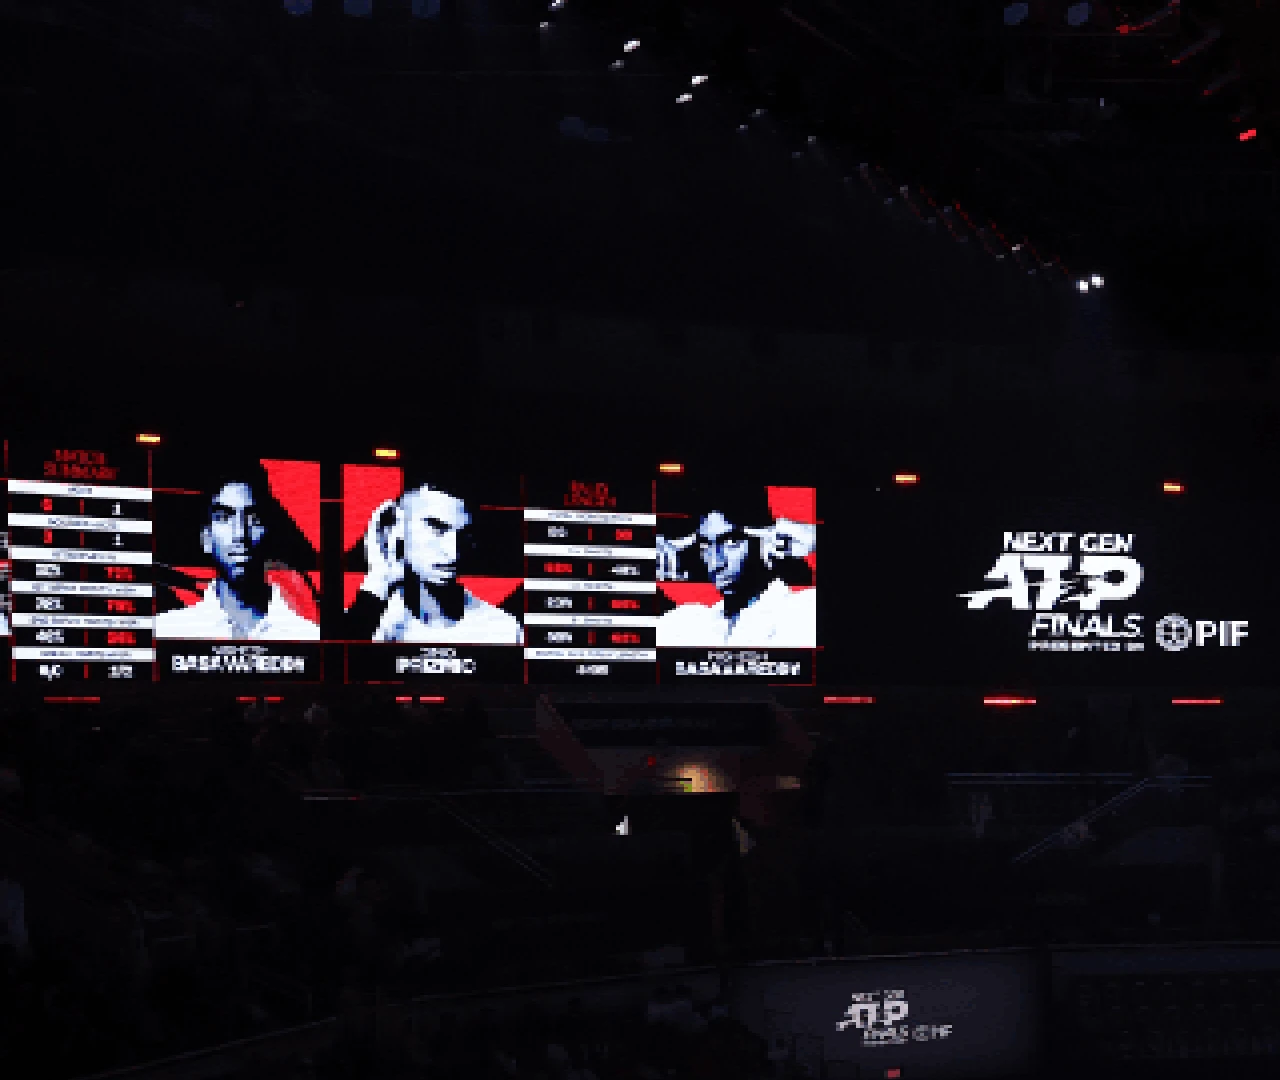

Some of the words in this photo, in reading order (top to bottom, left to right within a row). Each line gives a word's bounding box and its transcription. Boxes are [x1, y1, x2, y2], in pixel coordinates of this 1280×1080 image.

[1003, 531, 1075, 551] NEXT
[1080, 531, 1135, 551] GEN
[956, 552, 1145, 610] ATP
[1028, 613, 1145, 638] FINALS
[1196, 620, 1248, 646] PIF
